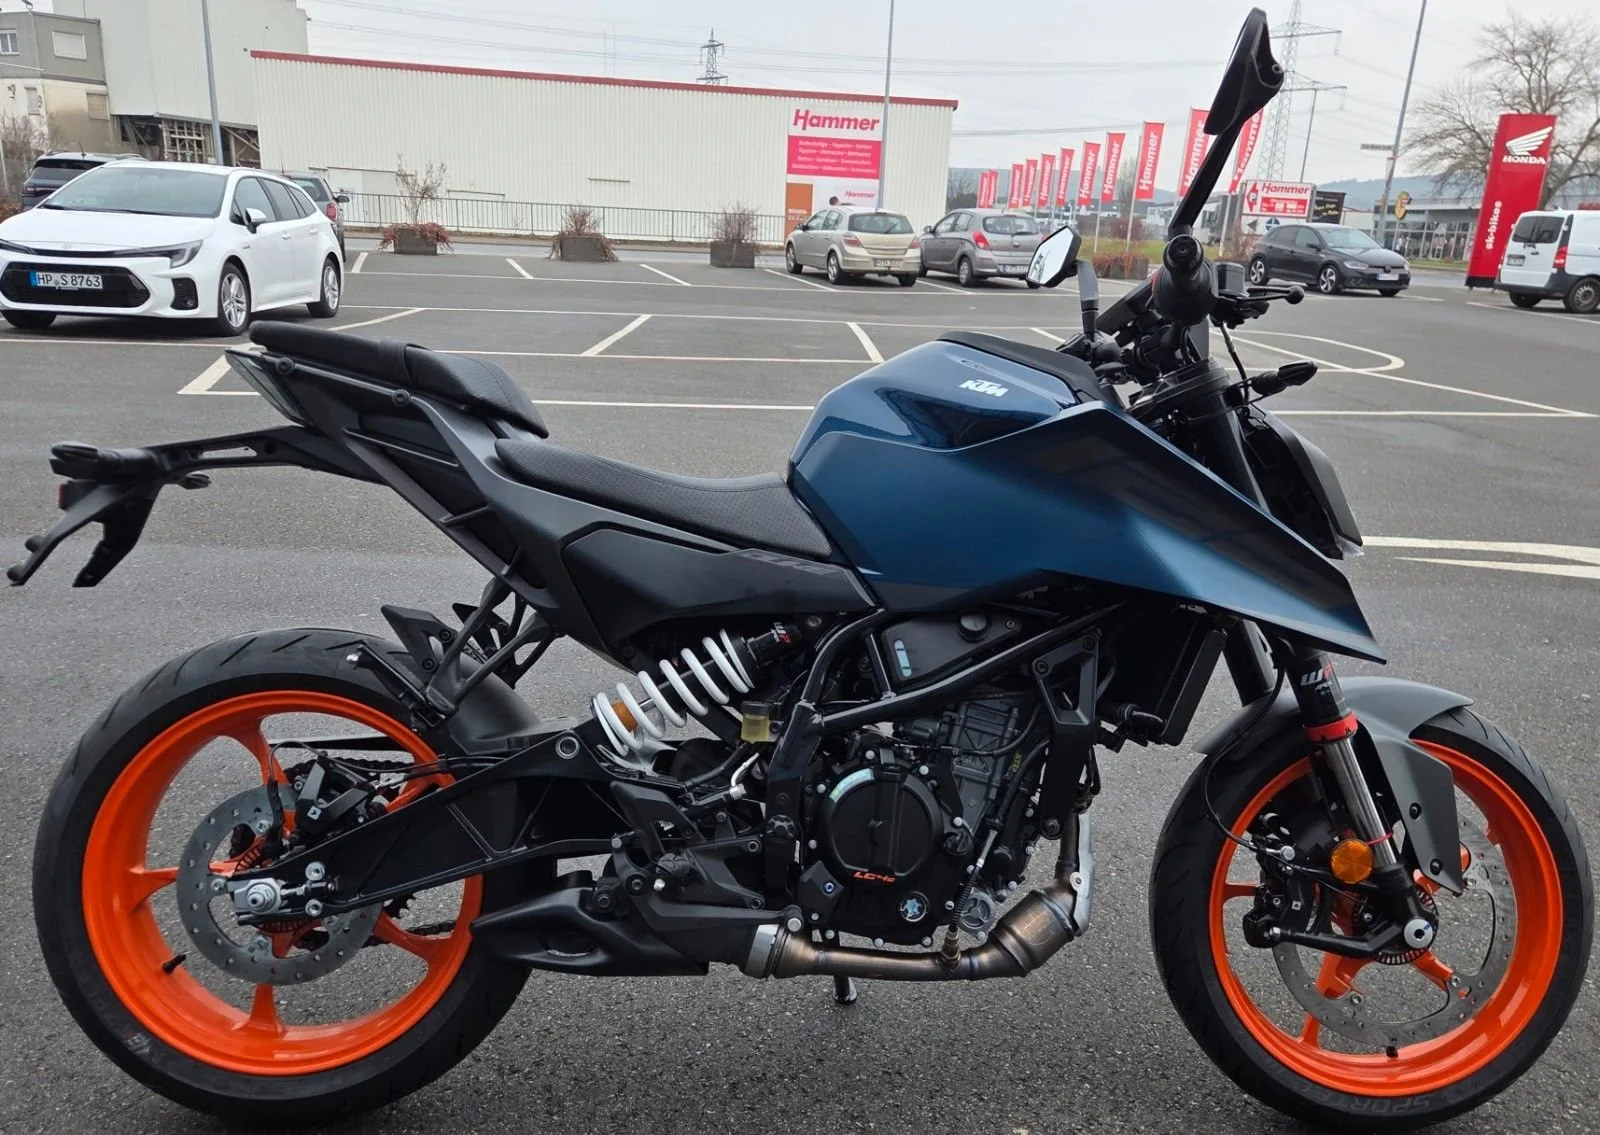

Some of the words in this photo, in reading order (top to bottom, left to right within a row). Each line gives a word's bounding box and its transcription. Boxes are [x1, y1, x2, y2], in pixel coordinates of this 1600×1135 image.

[793, 108, 880, 131] Hammer
[1103, 141, 1120, 194] Hammer
[1139, 132, 1160, 191] Hammer
[1502, 155, 1547, 165] HONDA
[1079, 149, 1096, 199] Hammer
[844, 189, 876, 199] Hammer
[1261, 182, 1310, 195] Hammer
[38, 272, 52, 285] HP
[60, 275, 68, 286] S
[71, 275, 101, 288] 8763
[958, 379, 1009, 397] KTM
